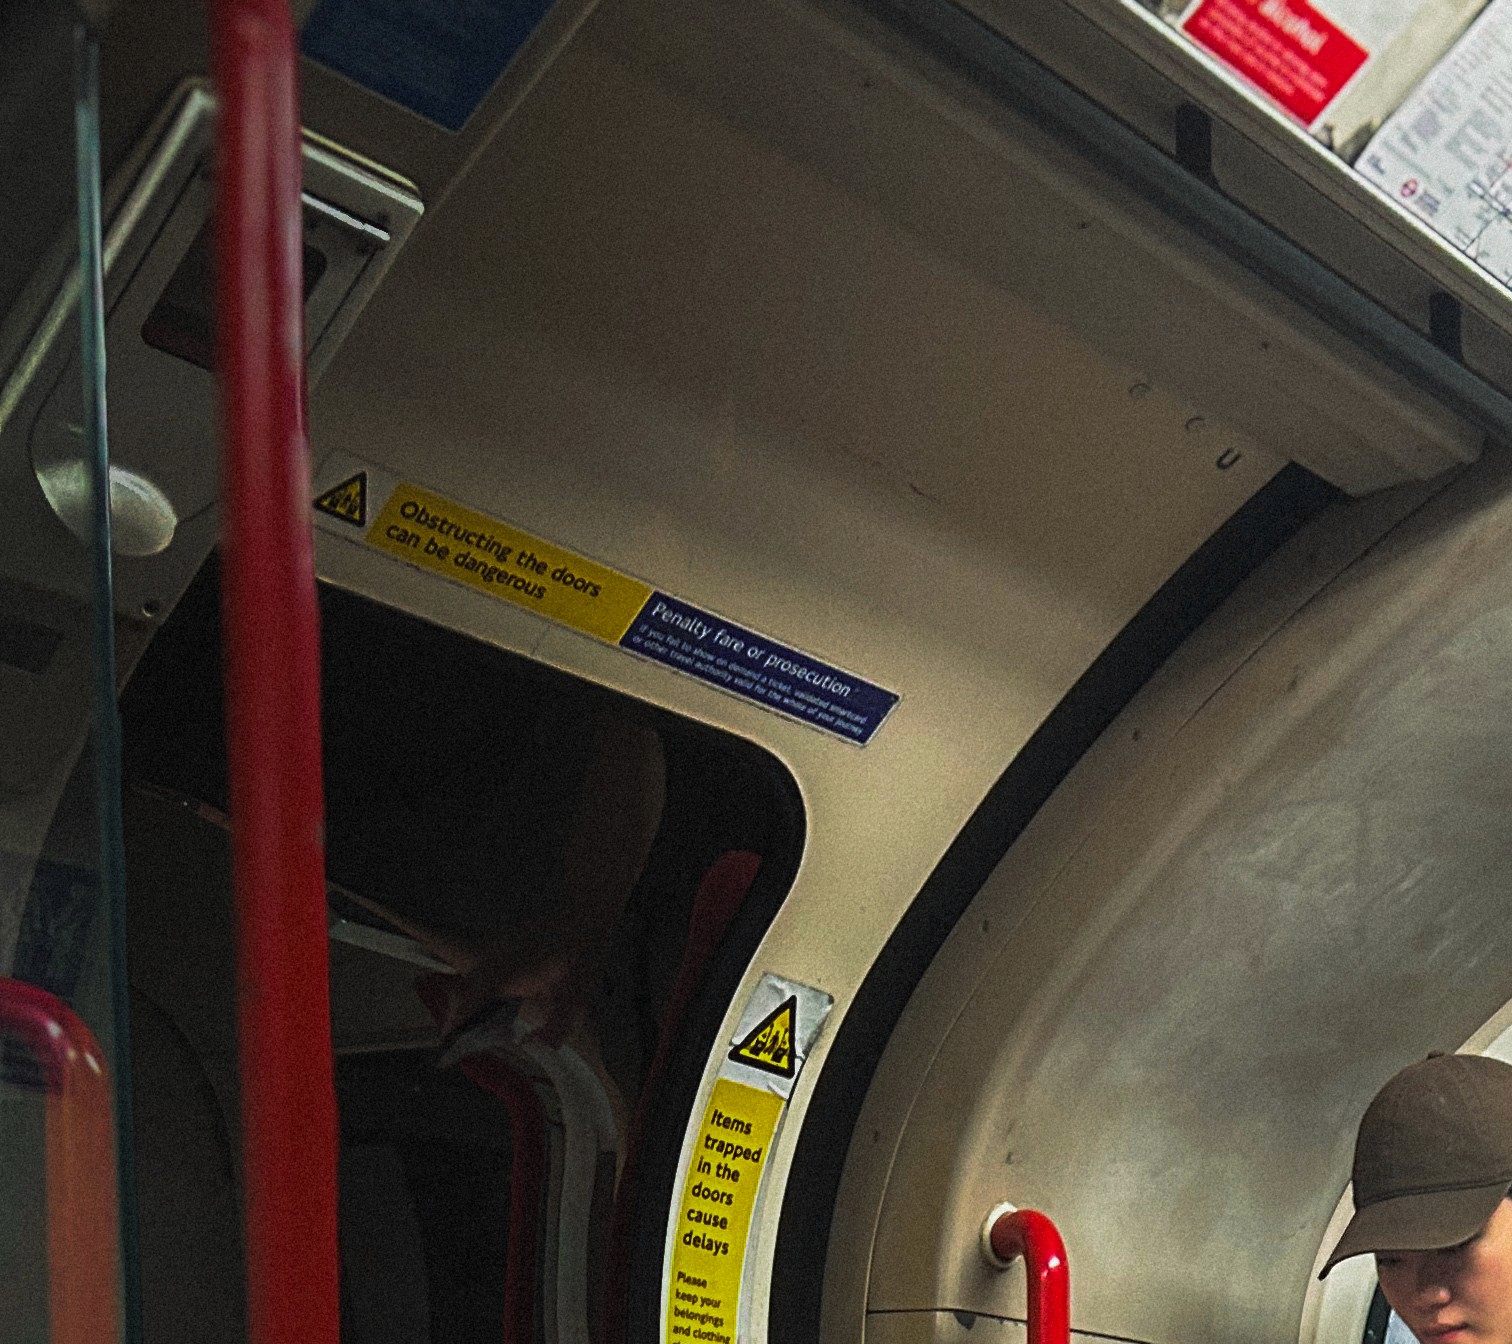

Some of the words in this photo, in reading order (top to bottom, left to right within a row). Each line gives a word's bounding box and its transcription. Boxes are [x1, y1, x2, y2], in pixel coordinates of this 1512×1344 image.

[386, 524, 421, 549] can
[424, 535, 450, 560] be
[453, 551, 547, 600] dangerous
[400, 501, 513, 562] Obstructing
[516, 550, 548, 576] the
[552, 566, 602, 598] doors
[652, 602, 712, 640] Penalty
[714, 628, 744, 652] fare
[747, 646, 766, 660] or
[764, 653, 851, 697] prosecution
[711, 1109, 752, 1135] Items
[704, 1134, 763, 1163] trapped
[697, 1155, 711, 1174] in
[716, 1162, 740, 1182] the
[692, 1181, 734, 1206] doors
[687, 1208, 728, 1230] cause
[683, 1230, 729, 1256] delays
[677, 1271, 707, 1288] Please
[676, 1288, 698, 1305] keep
[700, 1296, 721, 1308] your
[674, 1305, 724, 1328] belongings
[673, 1325, 691, 1337] and
